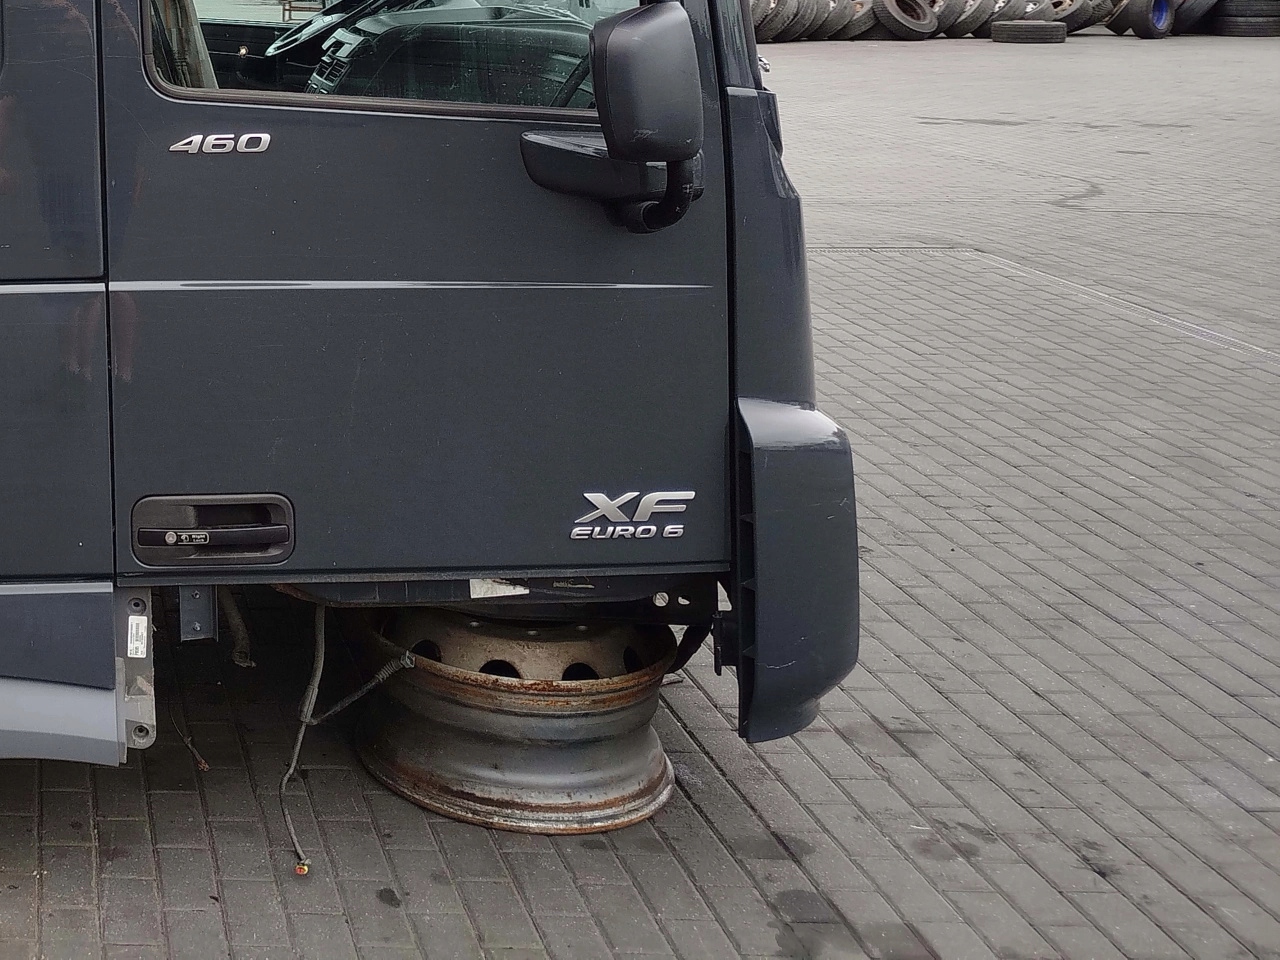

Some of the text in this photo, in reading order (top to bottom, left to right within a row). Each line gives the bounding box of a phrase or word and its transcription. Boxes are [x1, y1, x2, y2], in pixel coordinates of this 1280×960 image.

[169, 133, 271, 154] 460
[574, 491, 696, 523] XF
[570, 525, 685, 539] EURO 6
